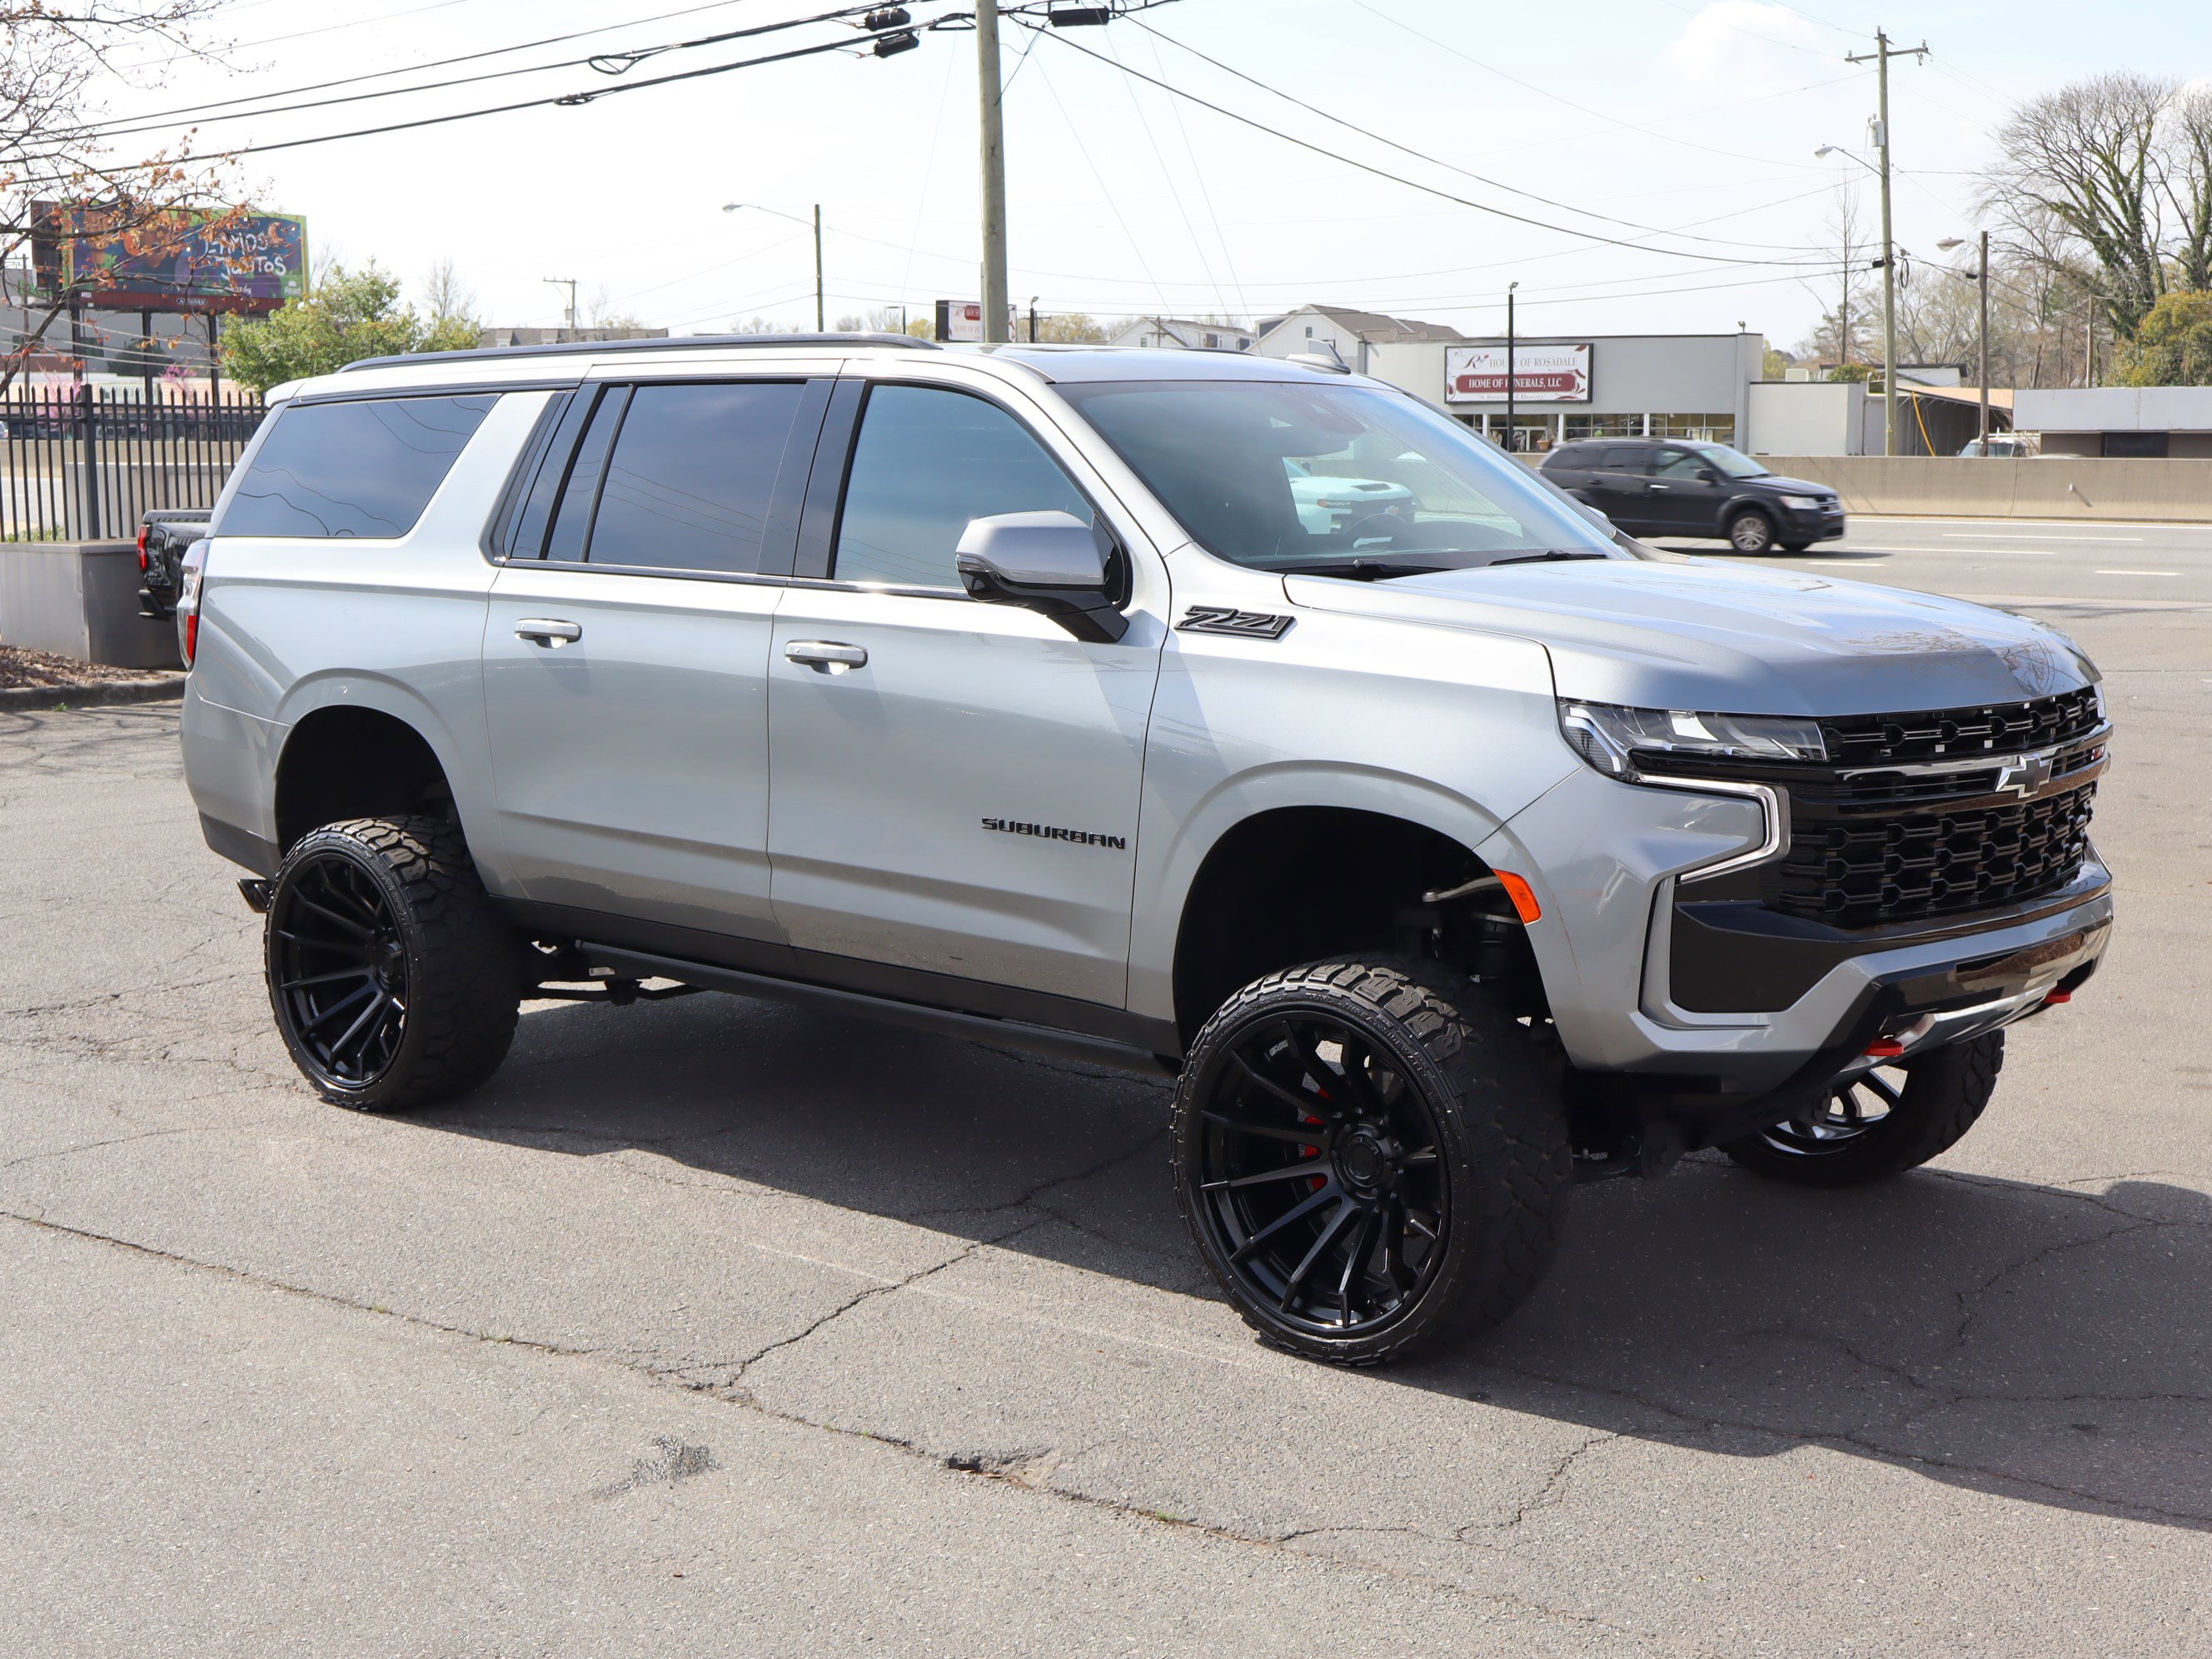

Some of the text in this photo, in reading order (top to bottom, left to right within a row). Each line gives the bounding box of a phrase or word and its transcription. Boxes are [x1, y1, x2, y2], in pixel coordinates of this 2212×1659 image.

[1489, 358, 1517, 368] HOUE
[1520, 357, 1532, 367] OF
[1534, 356, 1578, 367] ROSADALE
[1468, 377, 1562, 389] HOME OF FNERALS, LLC
[1173, 605, 1297, 640] Z71
[981, 816, 1125, 849] SUBURBAN
